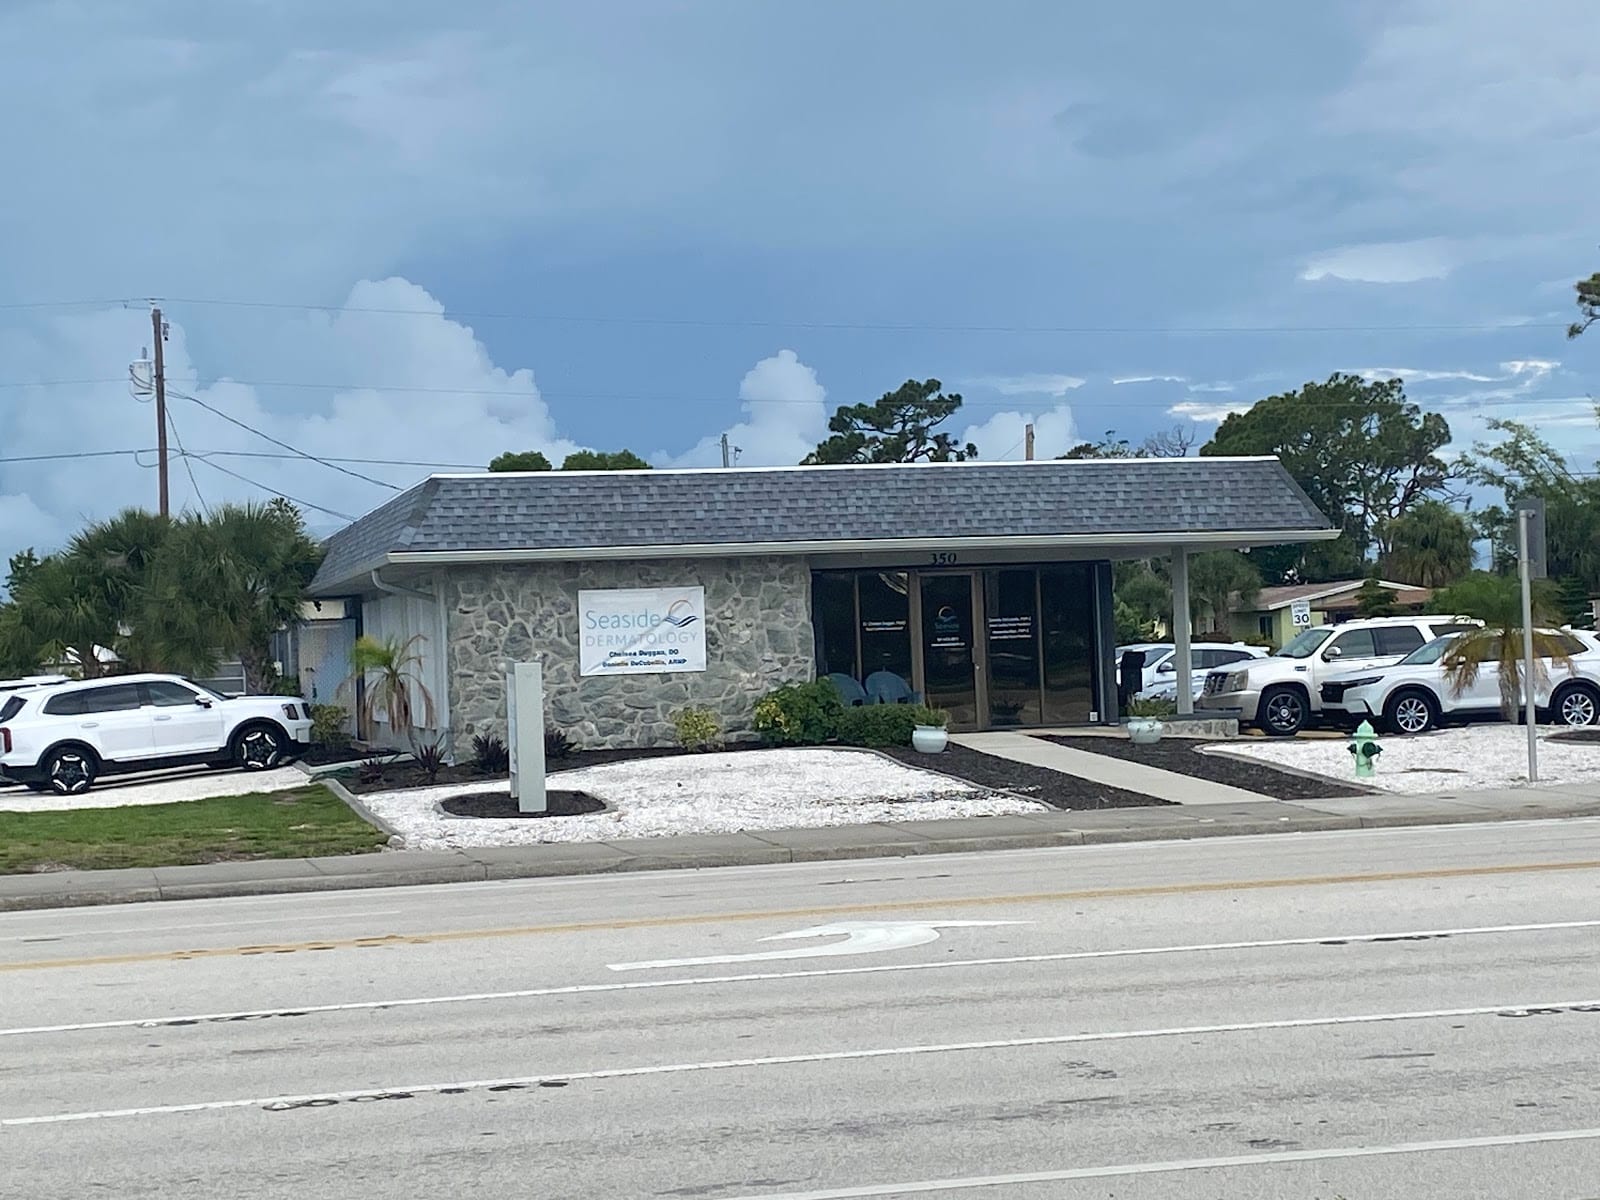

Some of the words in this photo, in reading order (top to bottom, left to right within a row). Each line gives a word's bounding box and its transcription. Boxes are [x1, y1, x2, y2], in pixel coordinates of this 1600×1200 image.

[930, 552, 957, 566] 350
[585, 609, 661, 630] Seaside
[1294, 613, 1310, 624] 30
[585, 632, 698, 647] DERMATOLOGY
[609, 650, 637, 658] Chelsea
